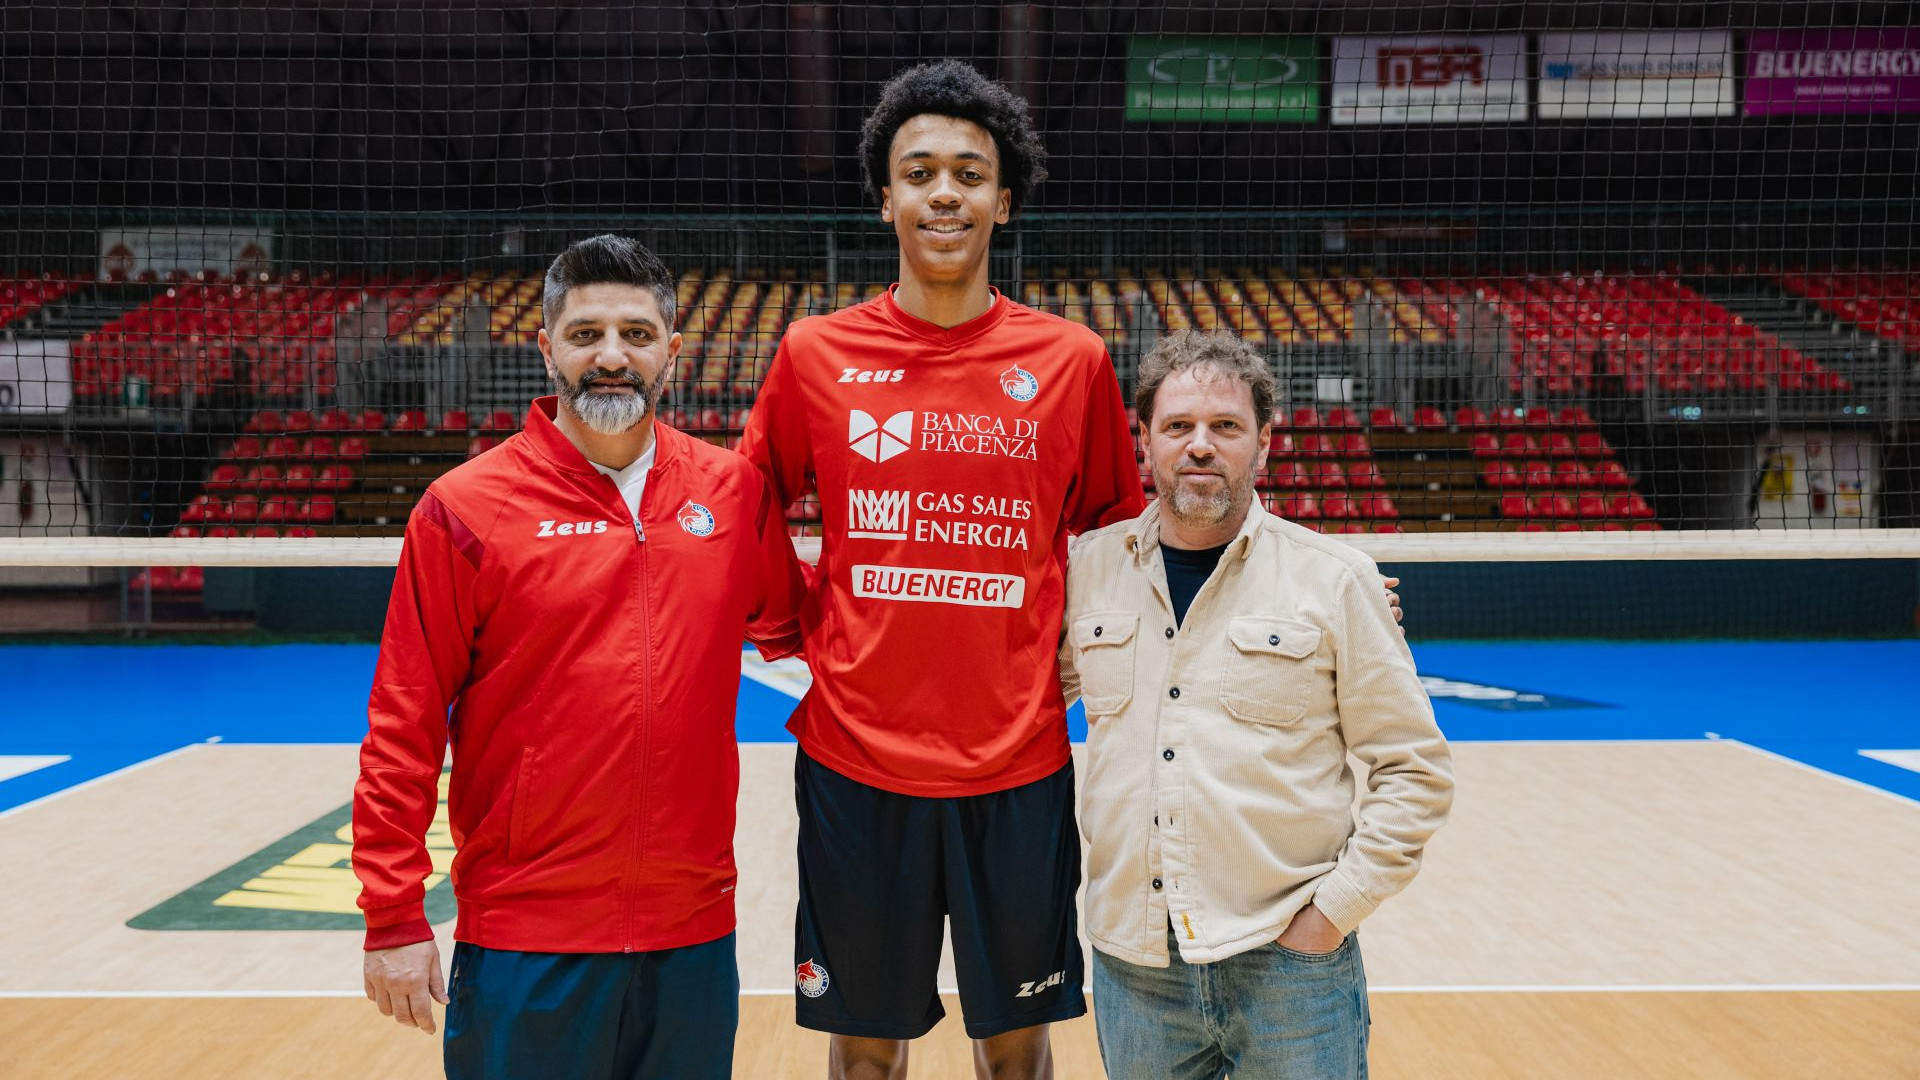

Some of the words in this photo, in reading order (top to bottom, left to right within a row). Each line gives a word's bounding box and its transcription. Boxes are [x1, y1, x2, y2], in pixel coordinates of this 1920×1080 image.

[1755, 50, 1920, 77] BLUENERGY
[837, 368, 905, 383] Zeus
[921, 411, 1006, 436] BANCA
[1014, 418, 1039, 439] DI
[920, 431, 1038, 461] PIACENZA
[916, 492, 965, 514] GAS
[971, 495, 1032, 520] SALES
[537, 520, 607, 537] Zeus
[914, 519, 1029, 551] ENERGIA
[862, 569, 1015, 602] BLUENERGY
